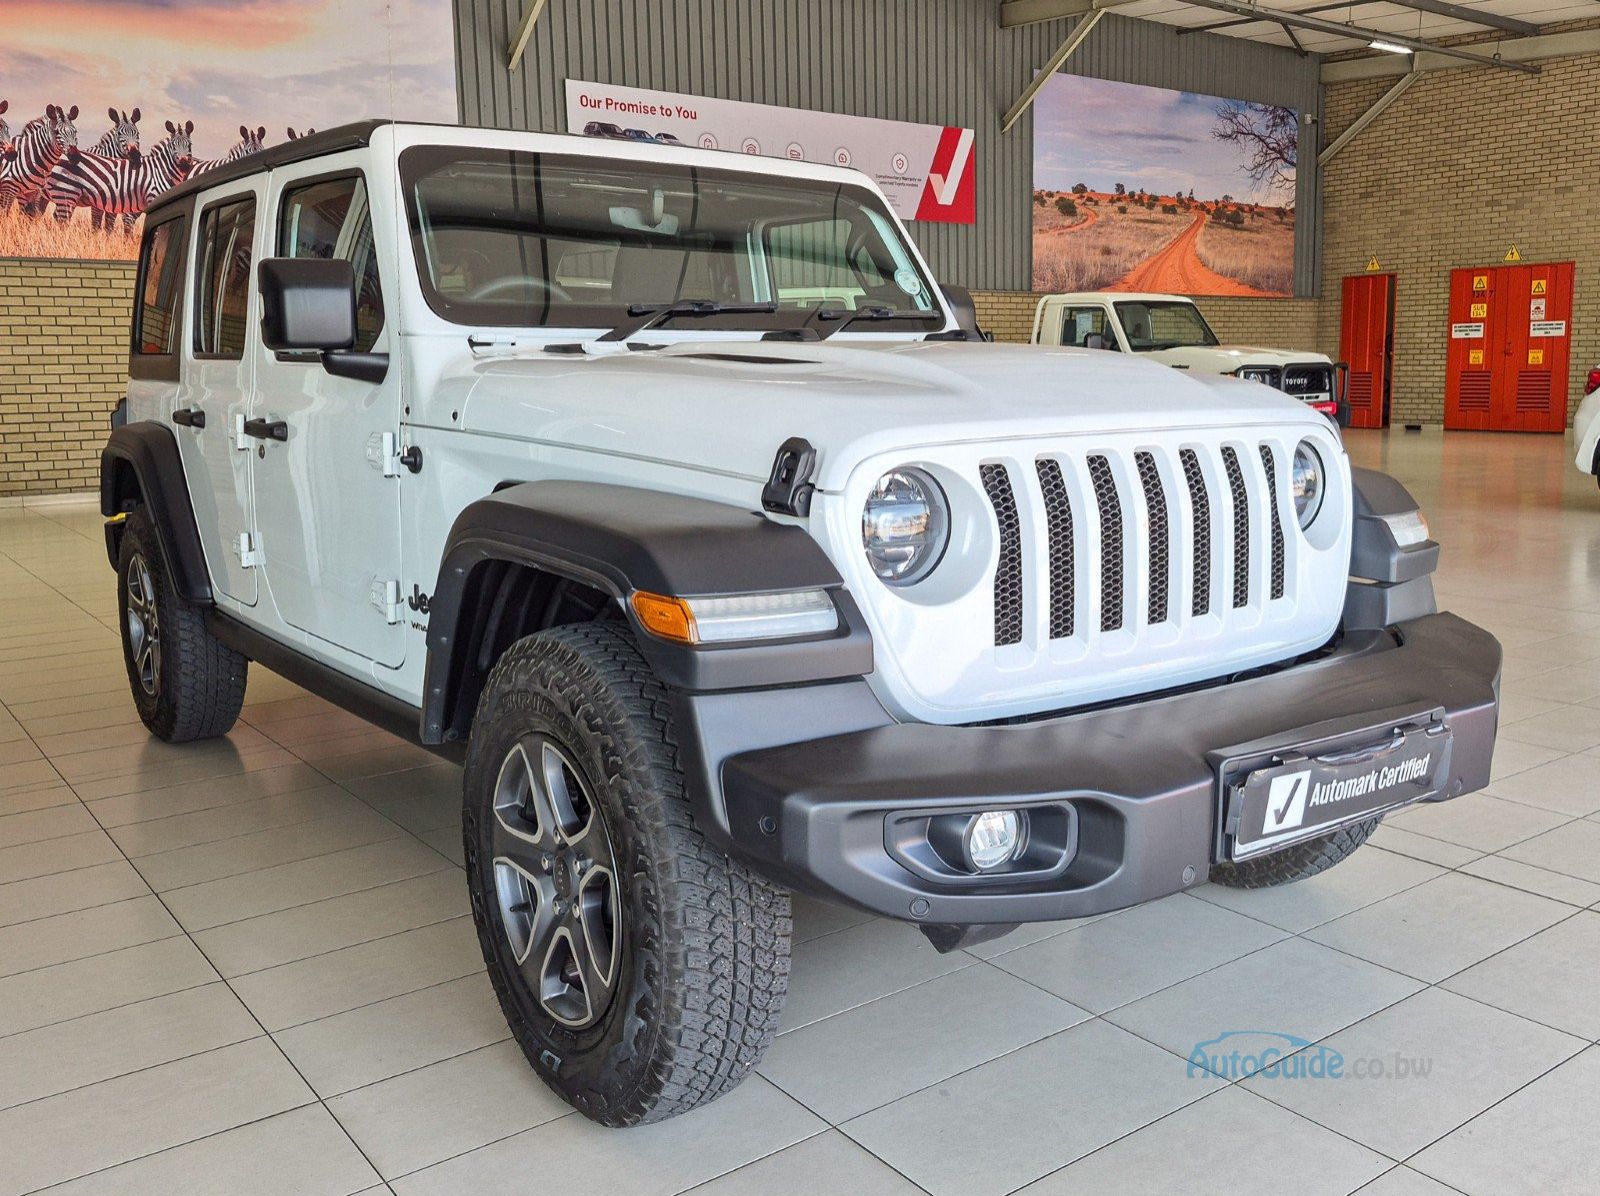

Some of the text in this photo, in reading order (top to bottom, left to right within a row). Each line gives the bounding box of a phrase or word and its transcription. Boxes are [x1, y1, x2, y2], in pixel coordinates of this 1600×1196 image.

[580, 94, 697, 120] Our Promise to You
[1309, 752, 1431, 807] Automark Certified
